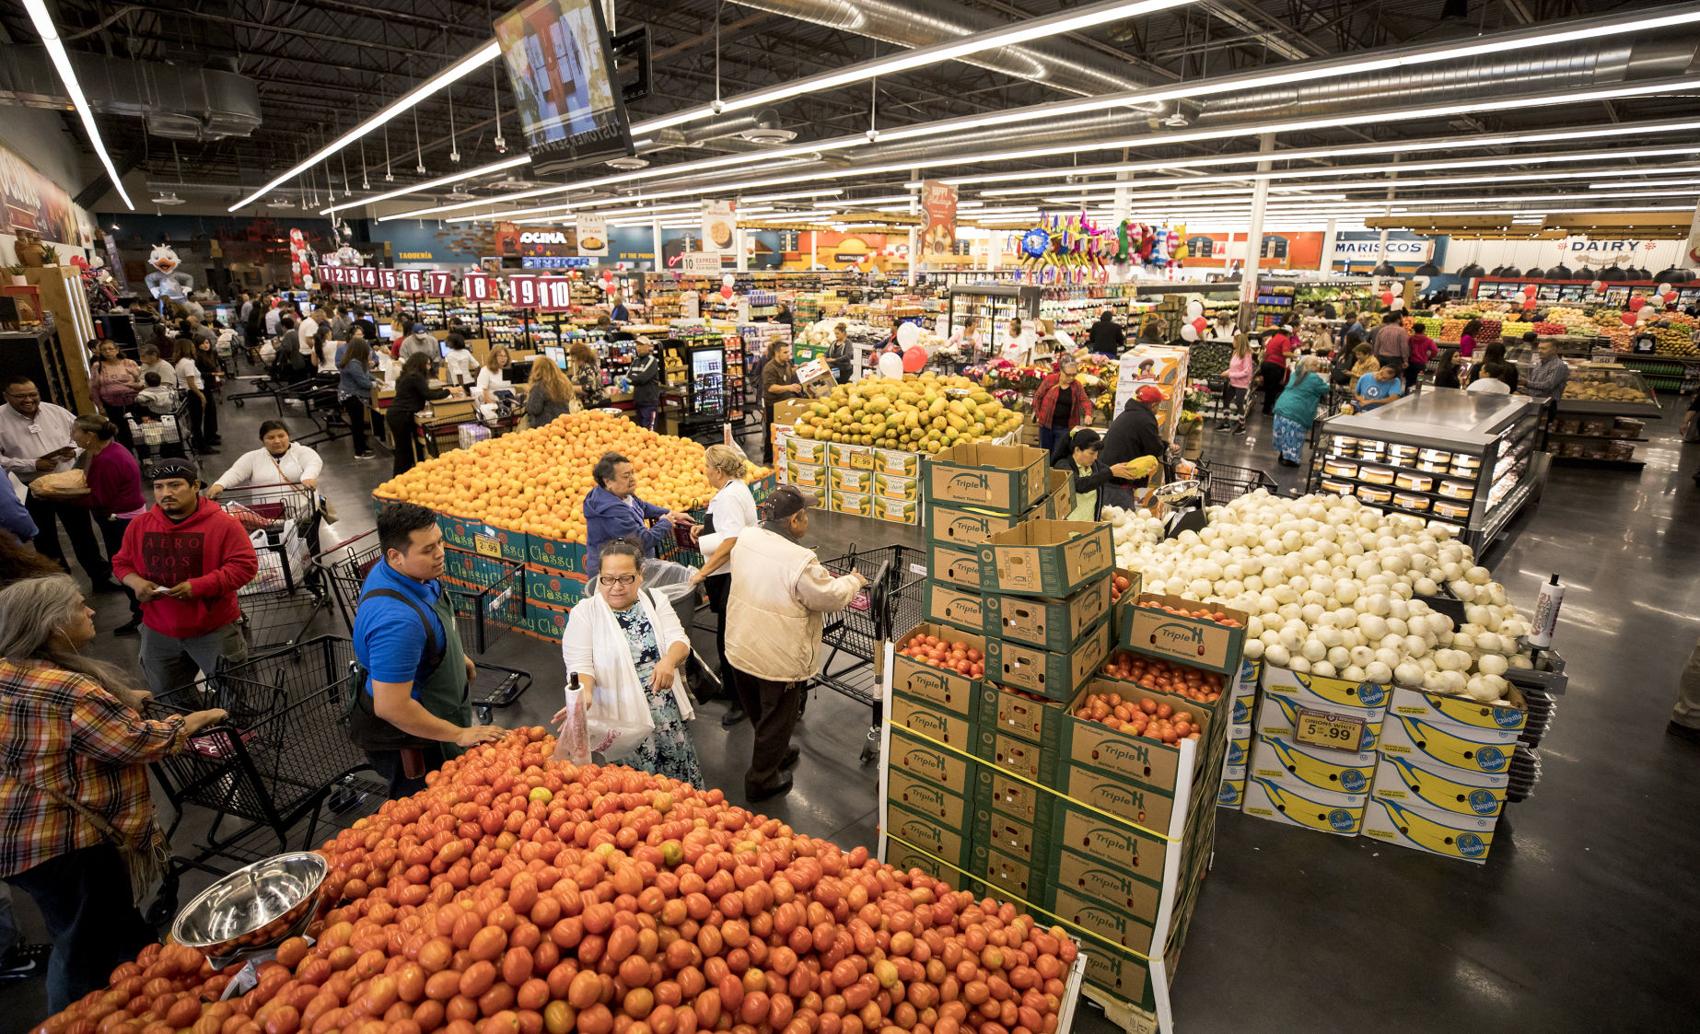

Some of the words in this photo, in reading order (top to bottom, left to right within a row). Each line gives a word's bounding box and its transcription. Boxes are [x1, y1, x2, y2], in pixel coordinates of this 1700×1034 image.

[1572, 241, 1640, 252] DAIRY
[323, 269, 329, 280] 1
[336, 269, 344, 282] 2
[350, 270, 358, 283] 3
[366, 270, 375, 286] 4
[385, 271, 395, 288] 5
[410, 273, 419, 290] 6
[437, 275, 447, 295] 7
[474, 277, 486, 298] 8
[522, 280, 534, 304] 9
[550, 282, 569, 307] 10
[956, 480, 979, 491] Triple
[980, 474, 989, 490] H
[958, 522, 980, 534] Triple
[980, 518, 989, 534] H
[145, 538, 200, 549] AERO
[445, 527, 474, 548] Class
[151, 556, 190, 567] POS
[530, 545, 574, 571] Classy
[957, 563, 980, 575] Triple
[955, 602, 978, 614] Triple
[1162, 629, 1190, 642] Triple
[1191, 626, 1204, 644] H
[916, 676, 940, 689] Triple
[940, 675, 949, 692] H
[1361, 692, 1384, 703] Chiquita
[914, 715, 938, 729] Triple
[938, 715, 947, 733] H
[1496, 714, 1523, 725] Chiquita
[1307, 724, 1317, 735] 5
[913, 754, 936, 767] Triple
[936, 754, 946, 771] H
[1105, 745, 1136, 760] Triple
[1137, 745, 1149, 765] H
[1480, 758, 1505, 768] Chiquita
[912, 789, 935, 803] Triple
[1101, 789, 1131, 804] Triple
[1132, 790, 1144, 810] H
[1472, 801, 1497, 811] Chiquita
[910, 825, 933, 839] Triple
[1096, 833, 1125, 850] Triple
[1126, 836, 1138, 855] H
[1091, 874, 1120, 890] Triple
[1121, 878, 1132, 897] H
[1086, 912, 1114, 929] Triple
[1115, 915, 1126, 934] H
